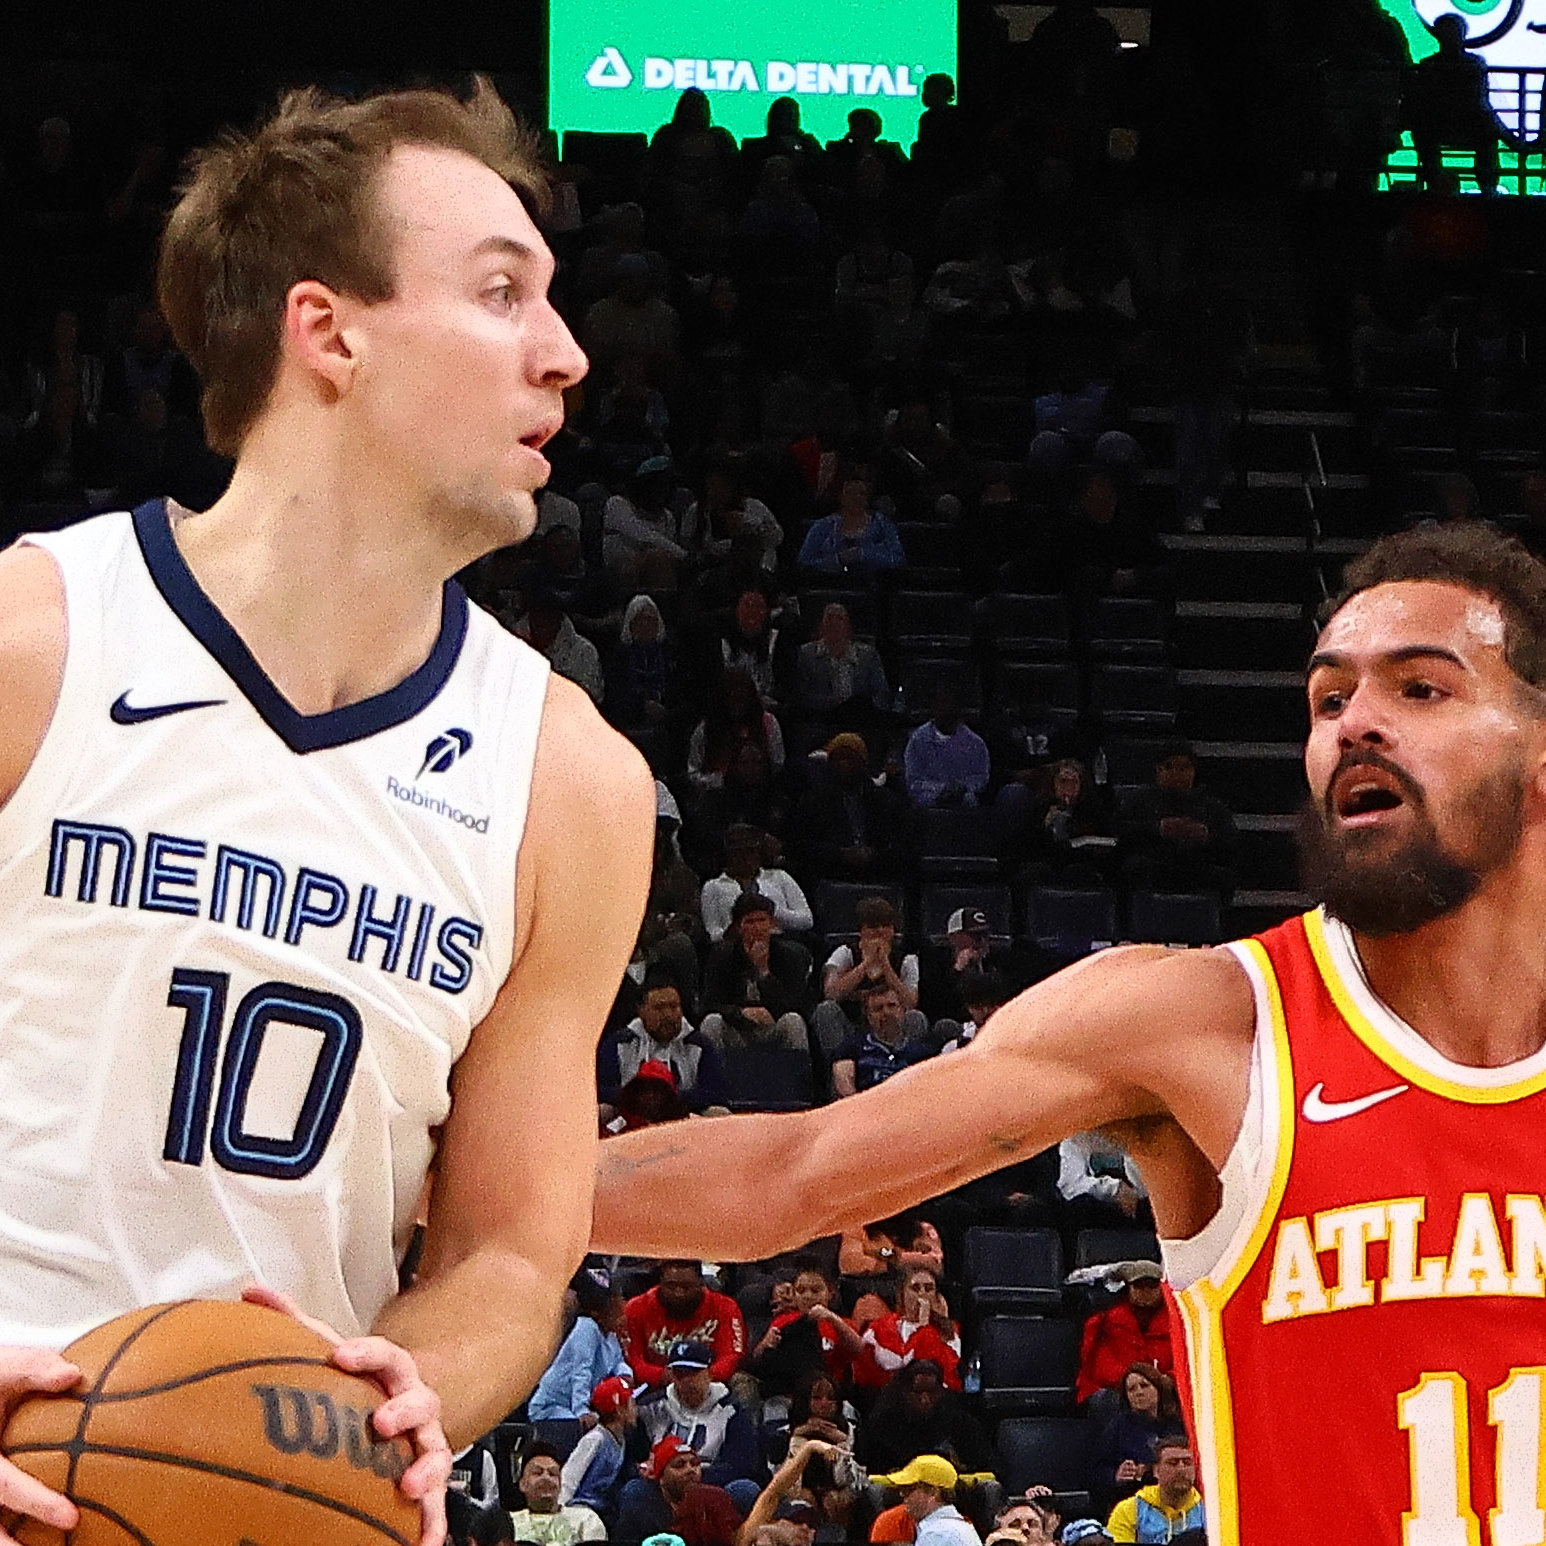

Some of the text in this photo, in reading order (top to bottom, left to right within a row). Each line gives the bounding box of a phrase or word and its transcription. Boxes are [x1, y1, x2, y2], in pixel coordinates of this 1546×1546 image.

[644, 57, 918, 97] DELTA DENTAL
[386, 775, 491, 835] Robinhood
[44, 819, 484, 995] MEMPHIS
[163, 968, 363, 1180] 10
